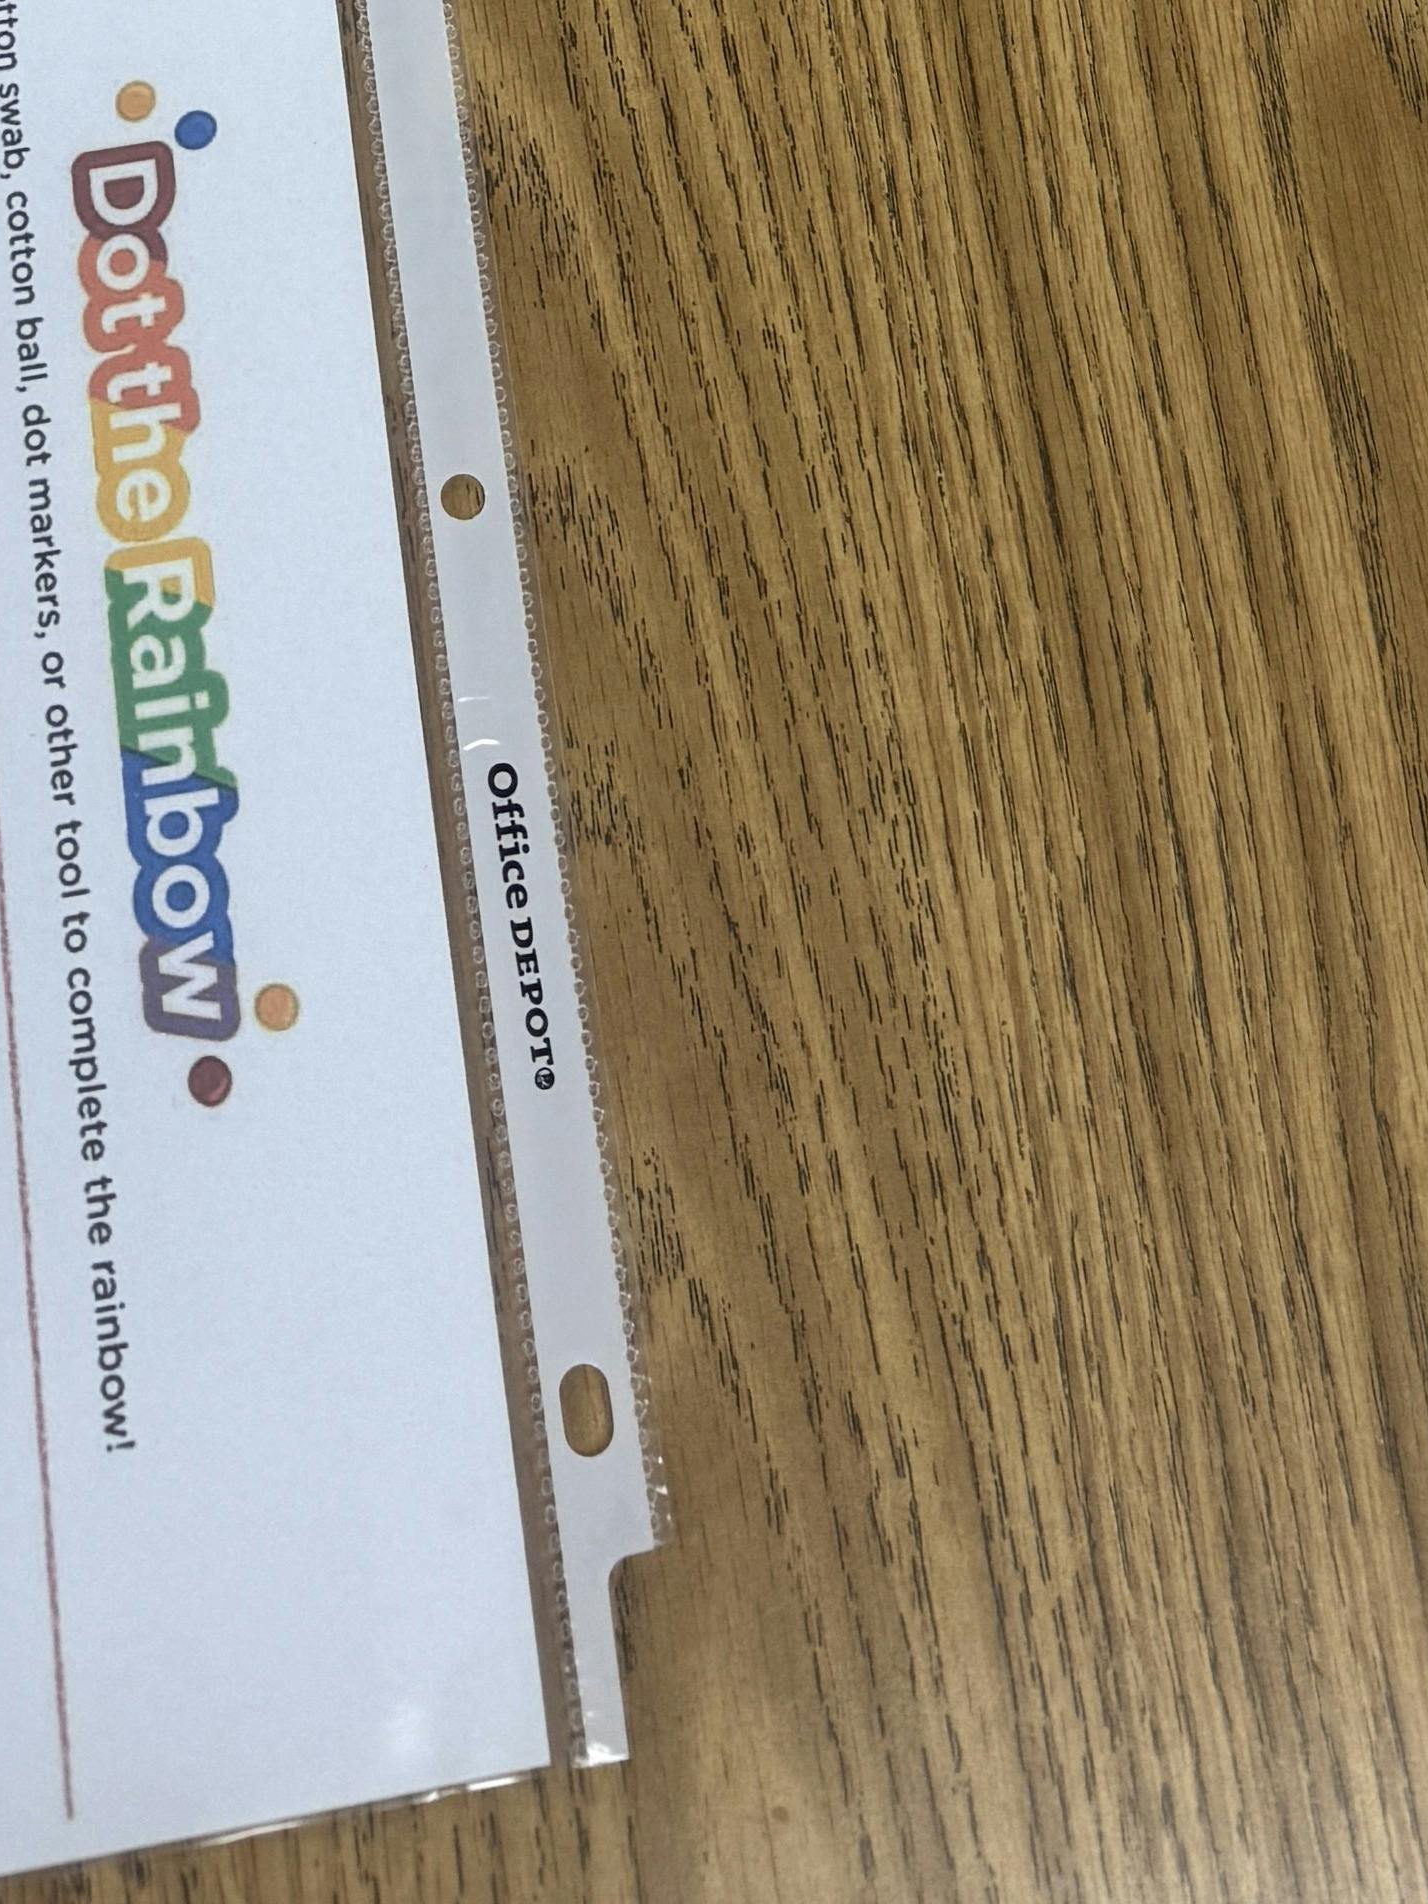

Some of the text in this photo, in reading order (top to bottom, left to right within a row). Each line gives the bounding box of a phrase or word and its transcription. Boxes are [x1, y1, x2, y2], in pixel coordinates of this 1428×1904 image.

[6, 191, 36, 306] cotton
[15, 317, 48, 392] ball,
[22, 404, 52, 467] dot
[28, 478, 62, 639] markers,
[87, 157, 223, 1023] Dot the Rainbow
[41, 651, 66, 689] or
[45, 704, 78, 806] other
[55, 820, 91, 899] tool
[488, 763, 530, 908] Office
[62, 911, 90, 953] to
[67, 967, 108, 1162] complete
[84, 1175, 117, 1246] the
[91, 1260, 136, 1453] rainbow!
